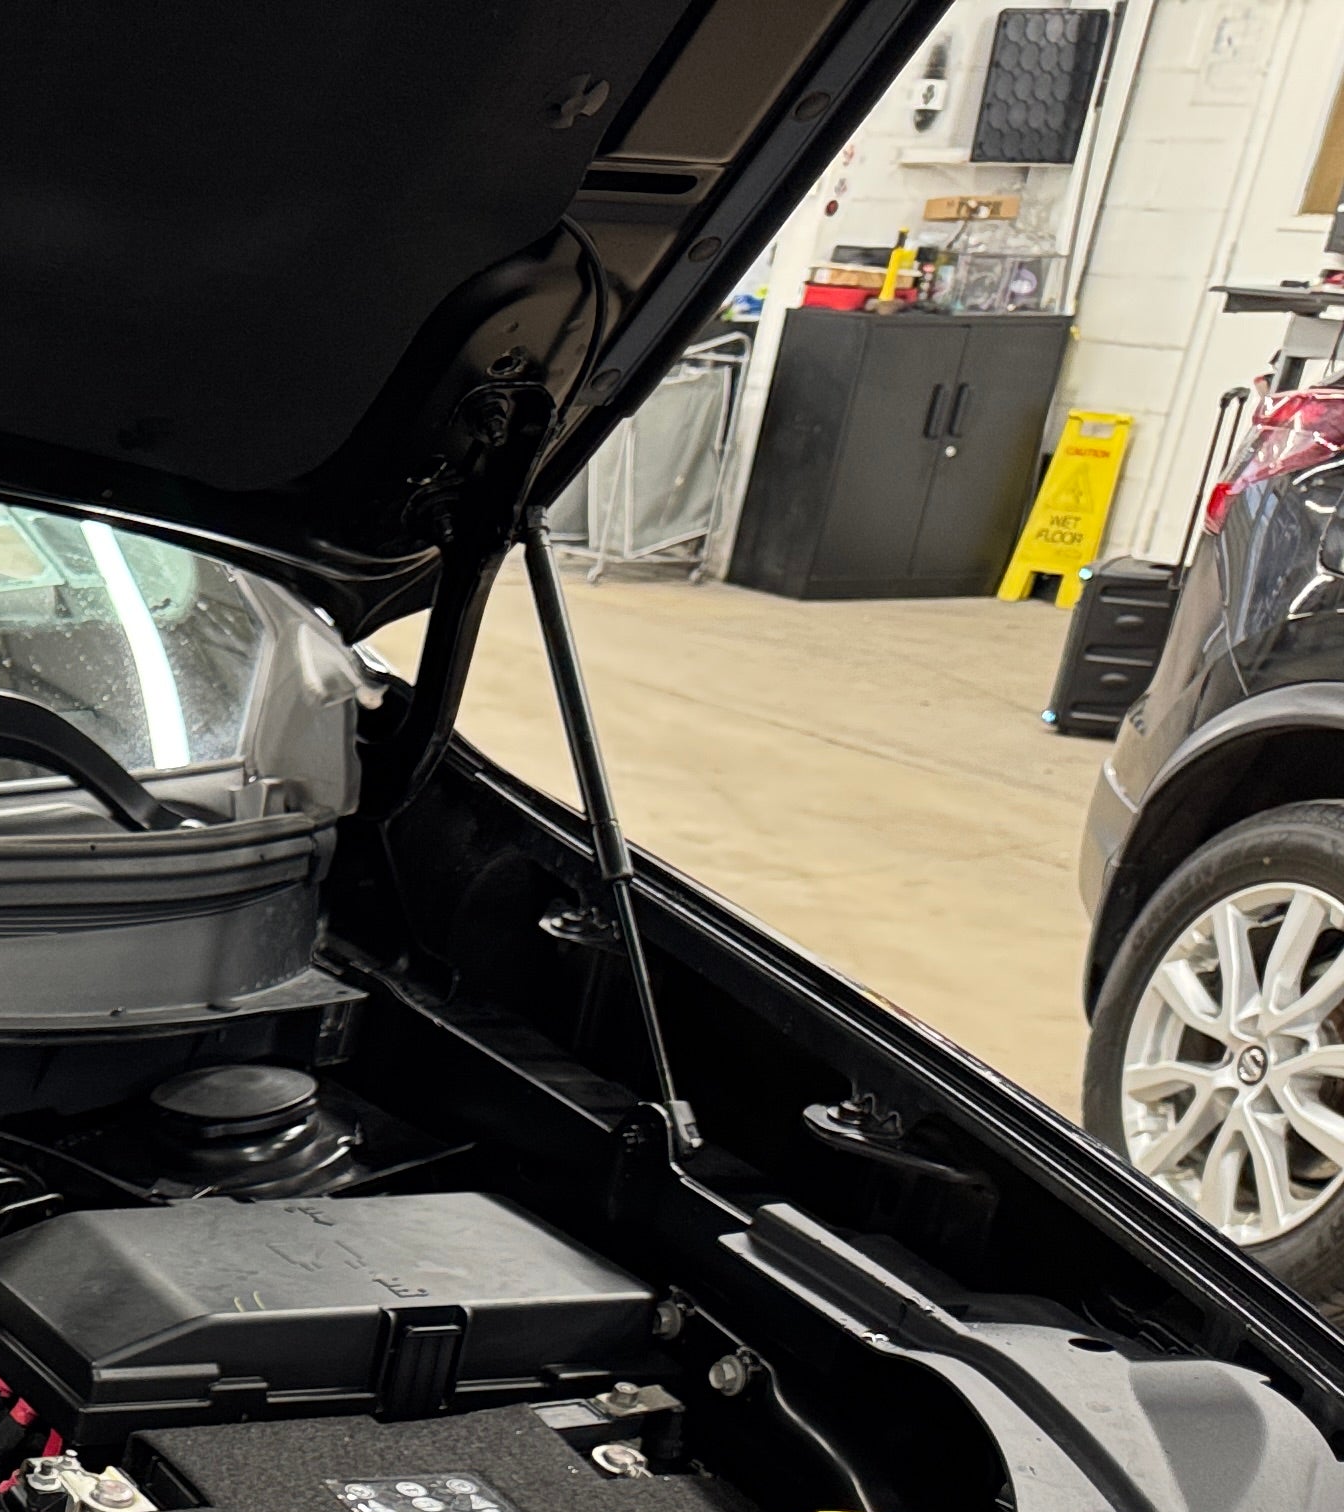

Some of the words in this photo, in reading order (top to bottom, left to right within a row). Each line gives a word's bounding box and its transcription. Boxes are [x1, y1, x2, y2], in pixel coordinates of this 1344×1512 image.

[1066, 447, 1110, 458] CAUTION
[1050, 515, 1082, 527] WET
[1035, 529, 1084, 544] FLOOR
